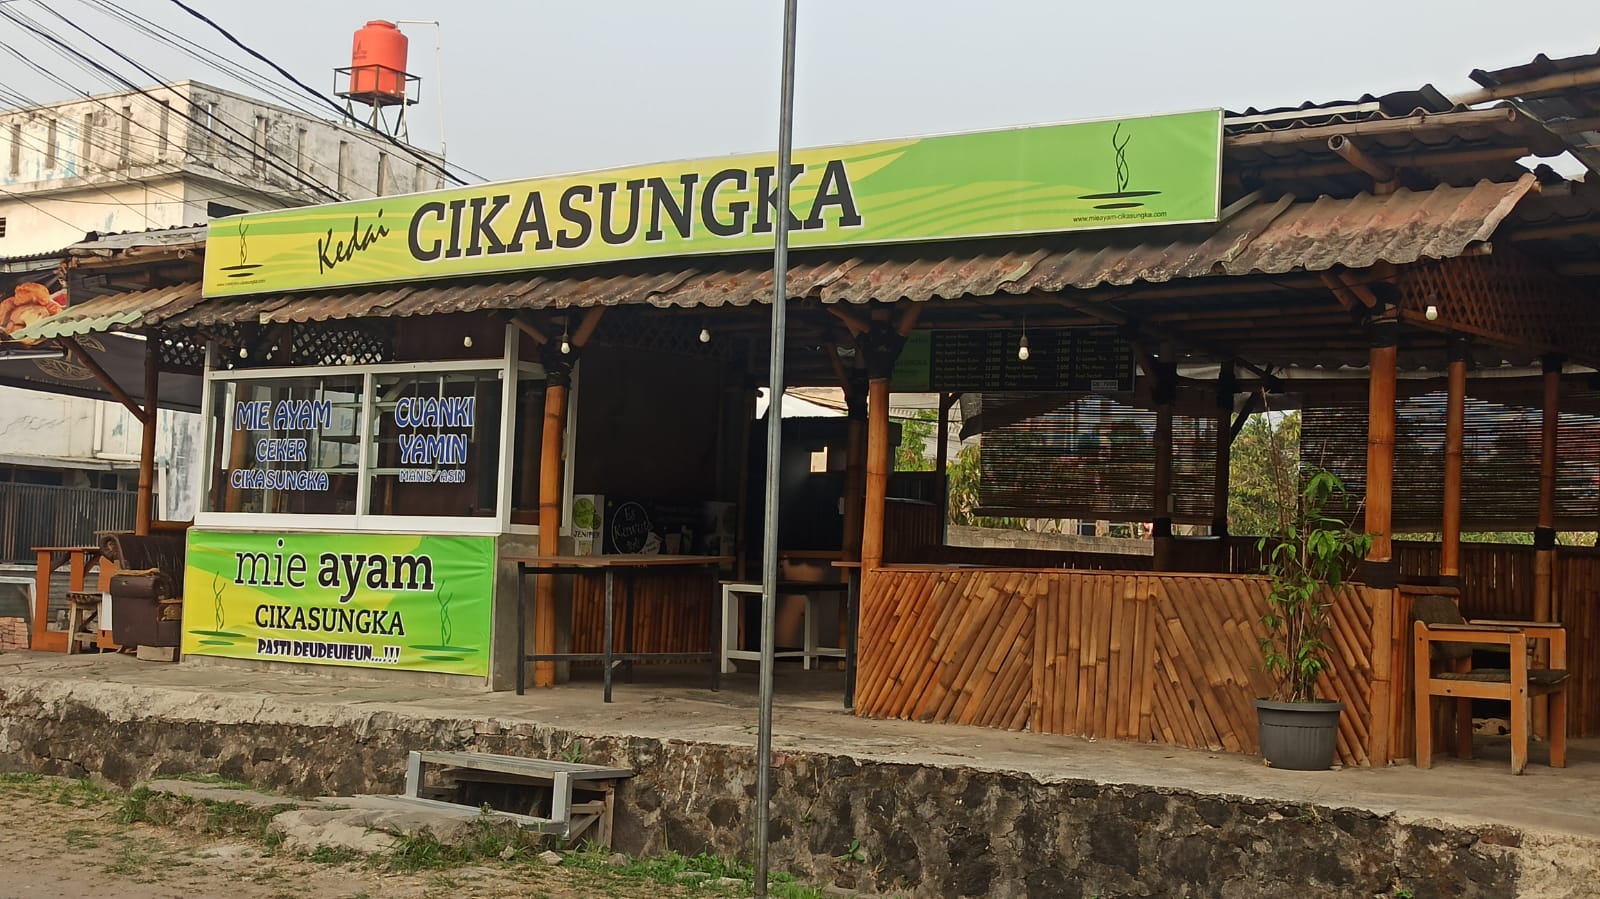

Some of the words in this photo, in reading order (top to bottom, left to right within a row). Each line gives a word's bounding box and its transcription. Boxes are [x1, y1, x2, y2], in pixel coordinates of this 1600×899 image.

[318, 208, 390, 274] Kedai
[407, 160, 862, 262] CIKASUNGKA
[235, 401, 270, 430] MIE
[273, 399, 331, 430] AYAM
[395, 397, 475, 428] CUANKI
[256, 439, 307, 462] CEKER
[400, 434, 467, 464] YAMIN
[231, 470, 329, 491] CIKASUNGKA
[234, 538, 307, 587] mie
[317, 551, 435, 603] ayam
[255, 604, 405, 636] CIKASUNGKA
[257, 638, 292, 656] PASTI
